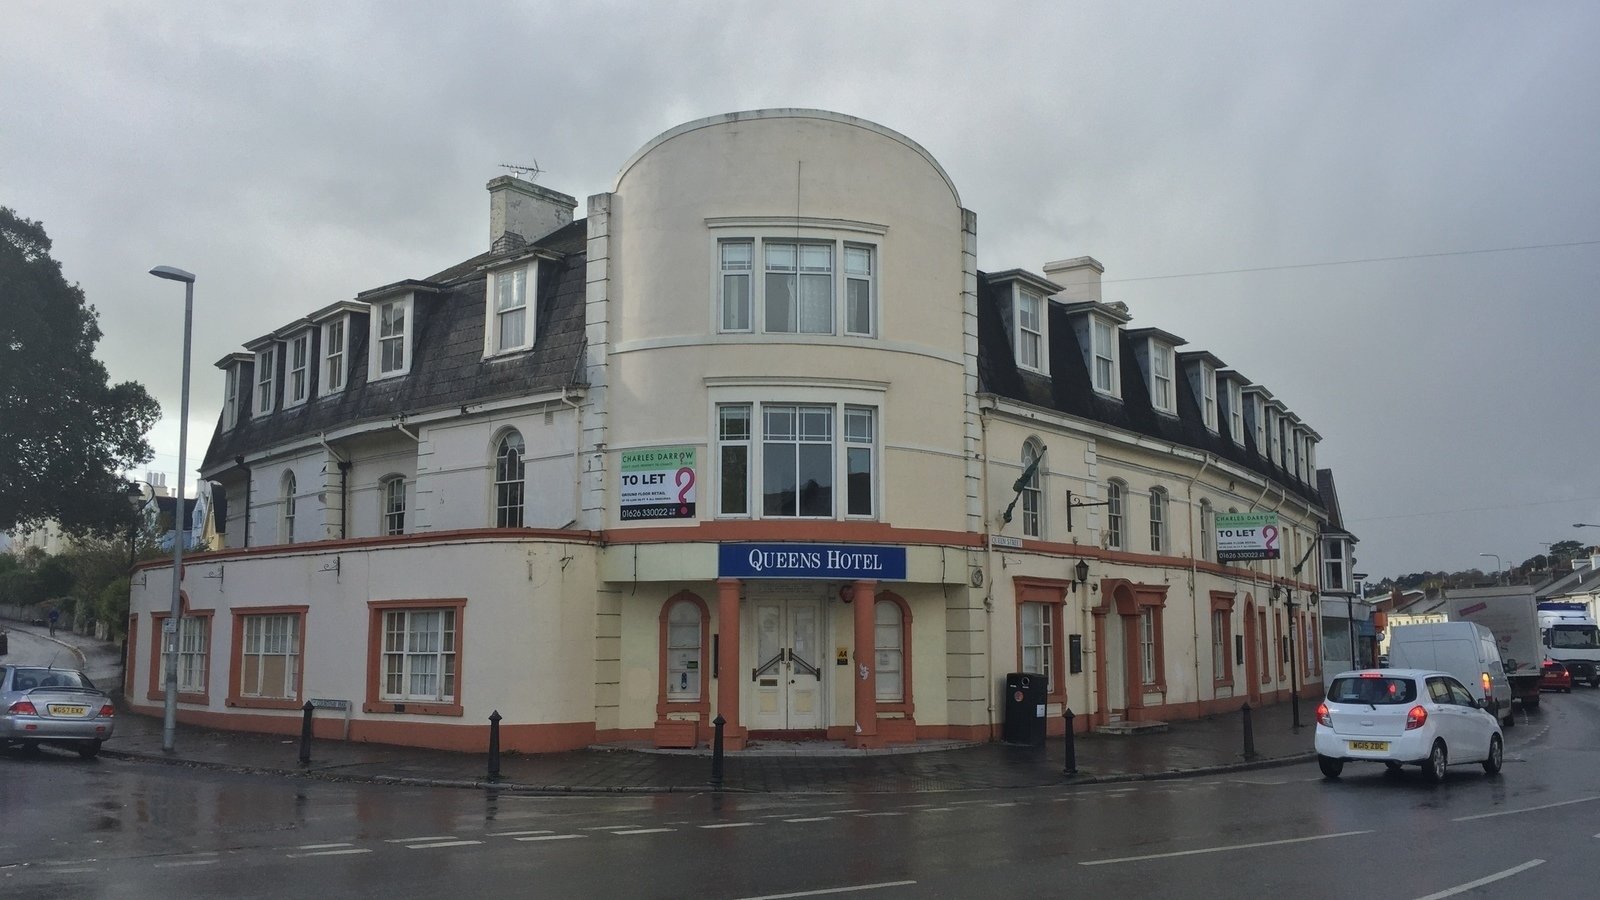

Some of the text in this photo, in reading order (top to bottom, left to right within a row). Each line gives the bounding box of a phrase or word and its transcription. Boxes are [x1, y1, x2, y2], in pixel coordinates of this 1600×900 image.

[622, 453, 654, 463] CHARLES
[622, 473, 666, 486] TO LET
[622, 508, 668, 518] 01626 330022
[1218, 529, 1256, 538] TO LET
[748, 548, 882, 572] QUEENS HOTEL
